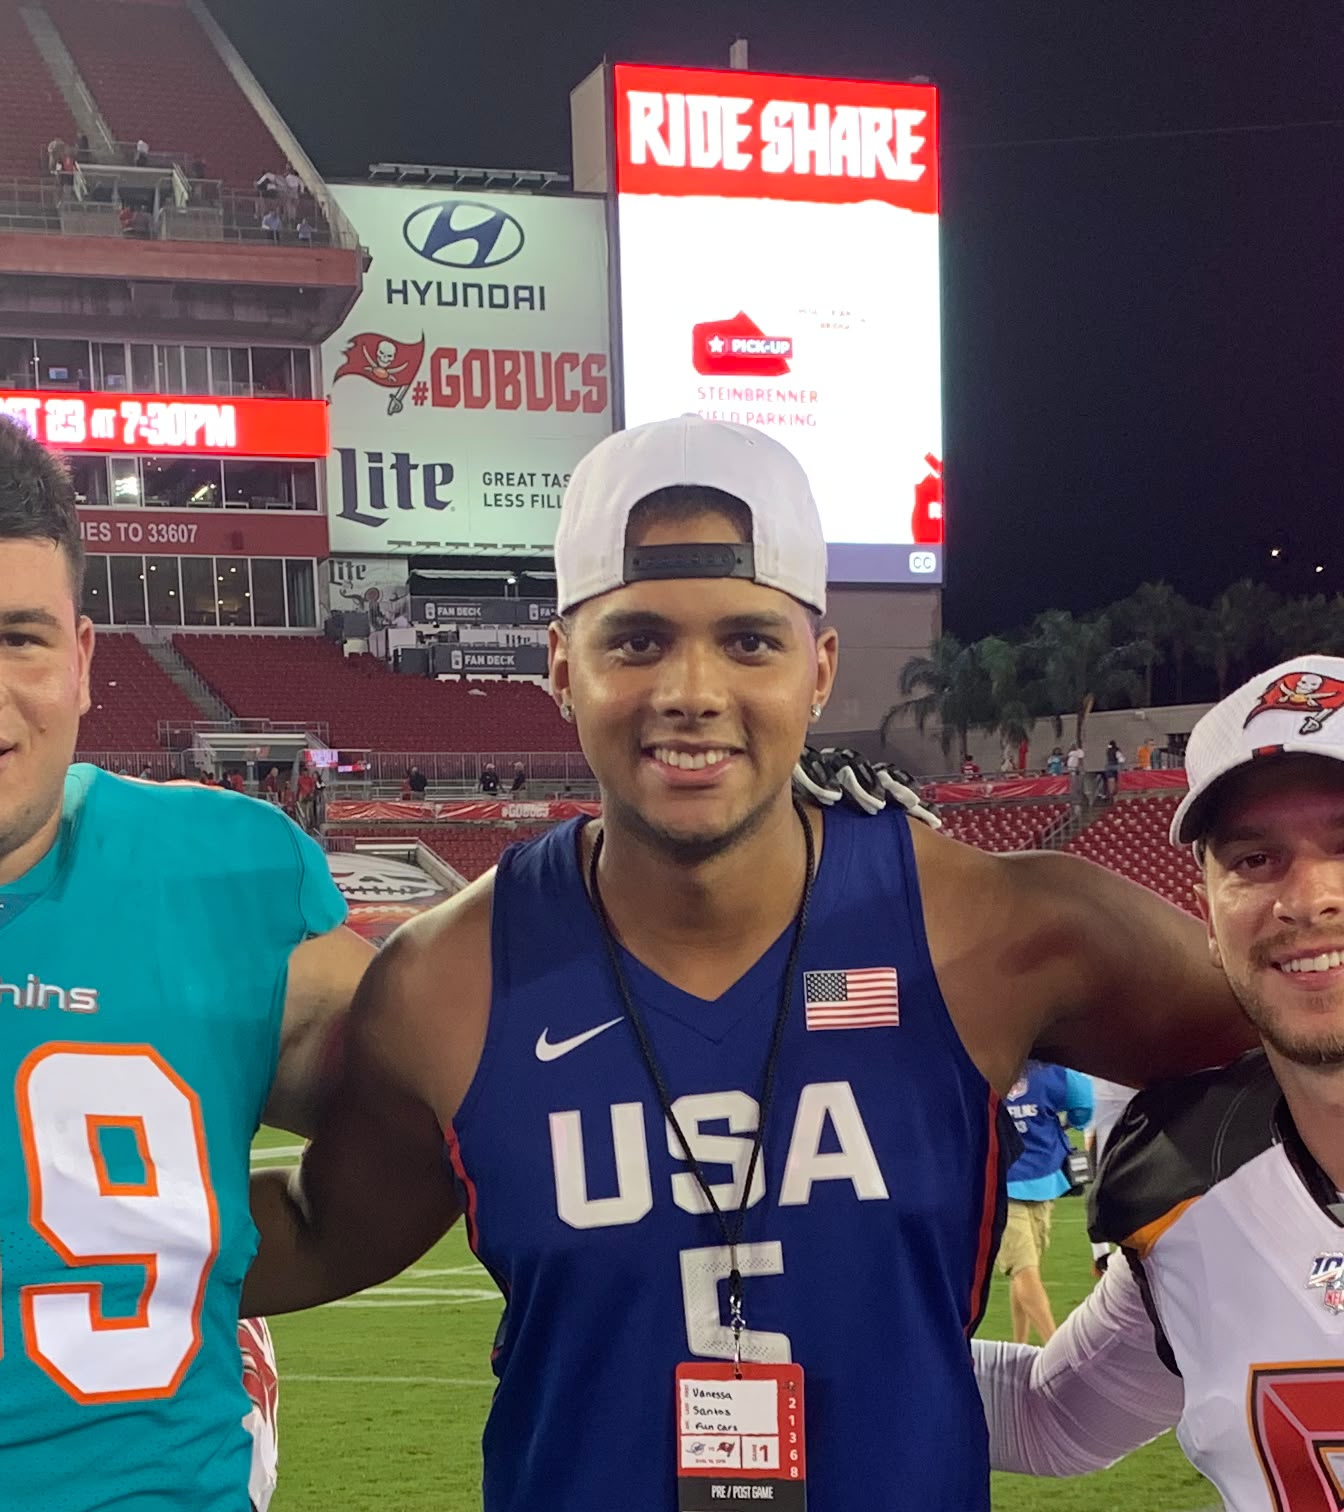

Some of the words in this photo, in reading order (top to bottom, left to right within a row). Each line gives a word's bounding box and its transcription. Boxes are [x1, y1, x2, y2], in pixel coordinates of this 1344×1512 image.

[626, 90, 754, 171] RIDE
[759, 100, 927, 182] SHARE
[385, 278, 546, 311] HYUNDAI
[732, 338, 791, 355] PICK-UP
[411, 346, 609, 414] #GOBUCS
[697, 386, 819, 404] STEINBRENNER
[44, 398, 87, 444] 23
[119, 400, 238, 448] 7:30PM
[745, 411, 817, 427] PARKING
[332, 446, 456, 528] Lite
[482, 472, 536, 488] GREAT
[541, 473, 570, 488] TAS
[483, 493, 525, 509] LESS
[530, 494, 564, 509] FILL
[116, 522, 143, 544] TO
[147, 522, 198, 545] 33607
[912, 556, 933, 570] CC
[437, 606, 455, 617] FAN
[456, 606, 482, 617] DECK
[464, 654, 485, 665] FAN
[486, 655, 515, 666] DECK
[548, 1080, 890, 1229] USA
[692, 1388, 733, 1400] Vanessa
[692, 1406, 732, 1416] Santos
[759, 1444, 769, 1462] 1
[711, 1485, 726, 1498] PRE
[732, 1485, 751, 1499] POST
[752, 1486, 774, 1499] GAME
